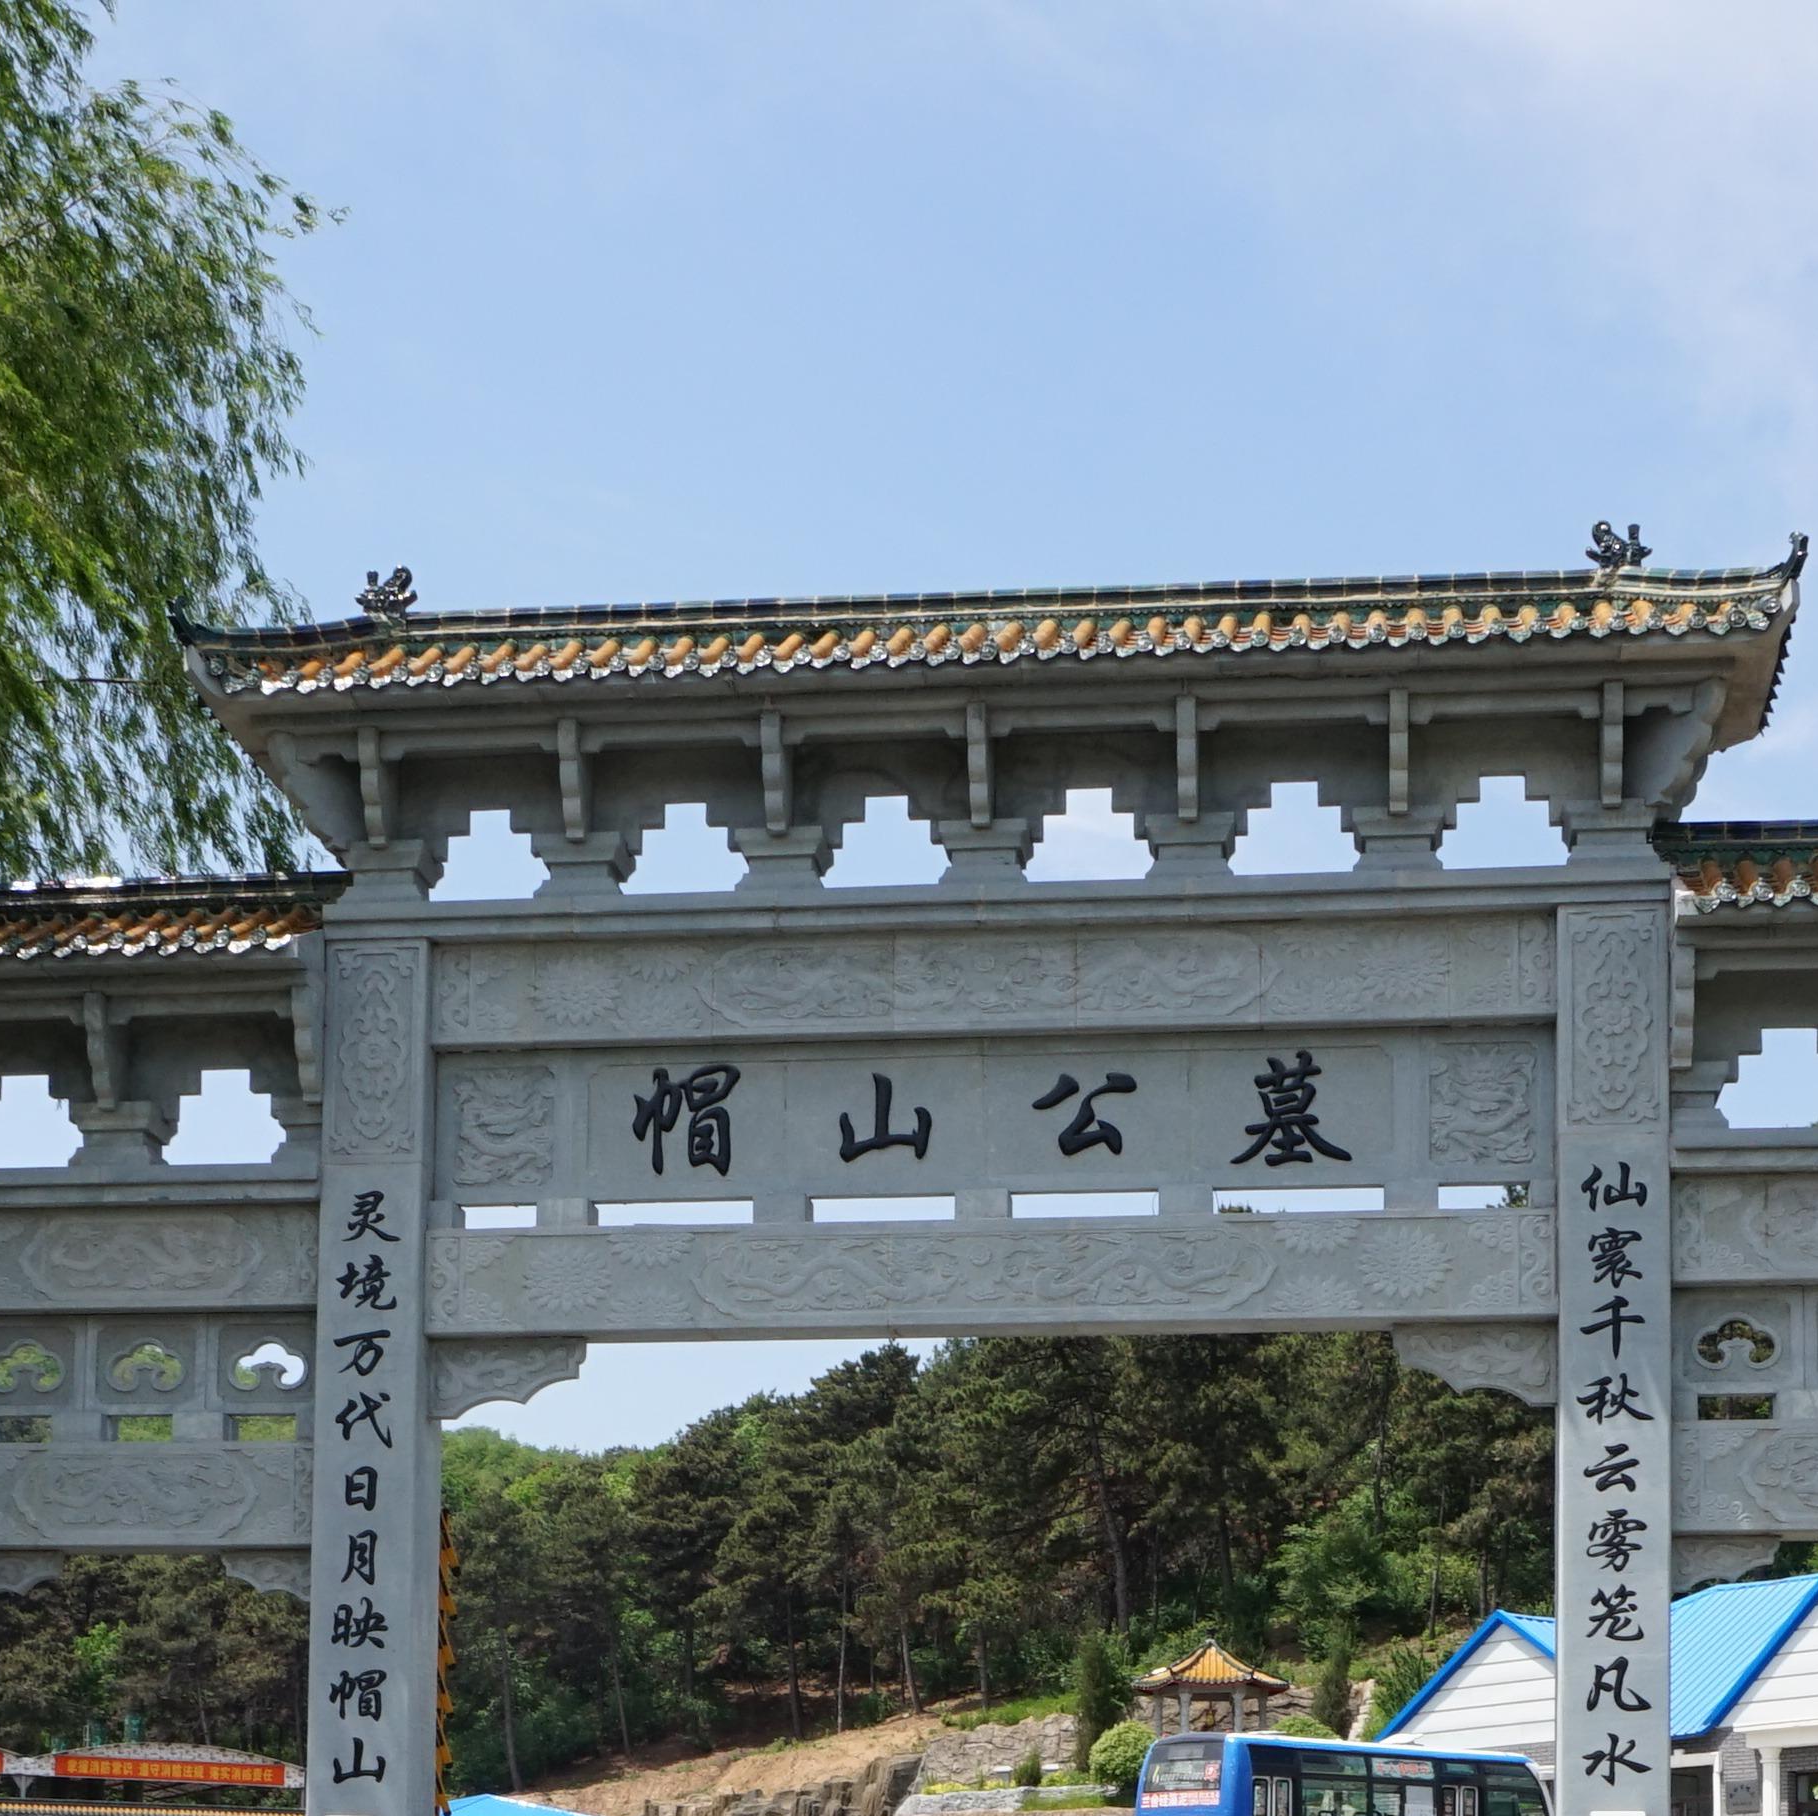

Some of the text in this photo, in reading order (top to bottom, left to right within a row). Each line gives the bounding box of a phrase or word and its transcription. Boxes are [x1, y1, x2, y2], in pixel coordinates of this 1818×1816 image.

[632, 1049, 1353, 1178] 帽山公墓
[329, 1190, 401, 1784] 灵境万代日月映帽山
